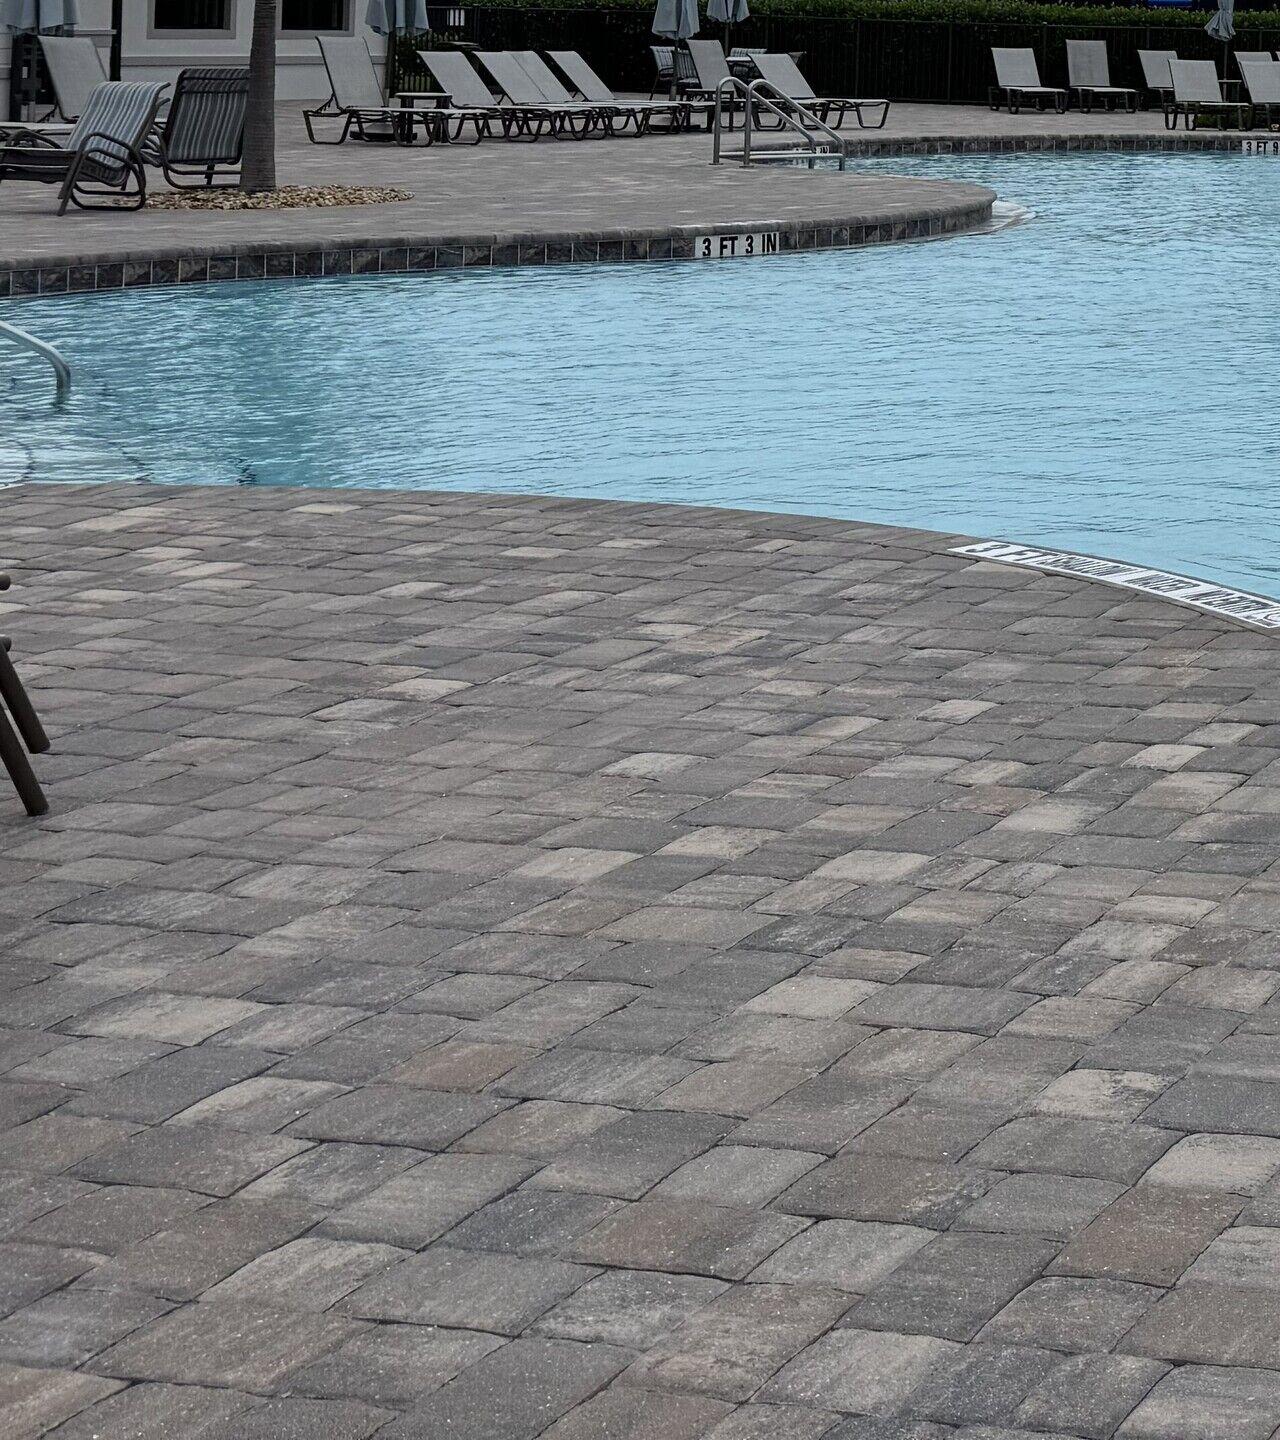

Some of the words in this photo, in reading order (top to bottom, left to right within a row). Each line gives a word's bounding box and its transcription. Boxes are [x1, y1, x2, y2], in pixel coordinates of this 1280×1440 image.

[1256, 141, 1268, 153] FT
[702, 237, 712, 257] 3
[719, 235, 738, 256] FT
[745, 234, 754, 254] 3
[762, 232, 777, 253] IN
[991, 548, 1063, 562] FT
[1123, 573, 1201, 593] WATER
[1201, 596, 1280, 615] ENTRY
